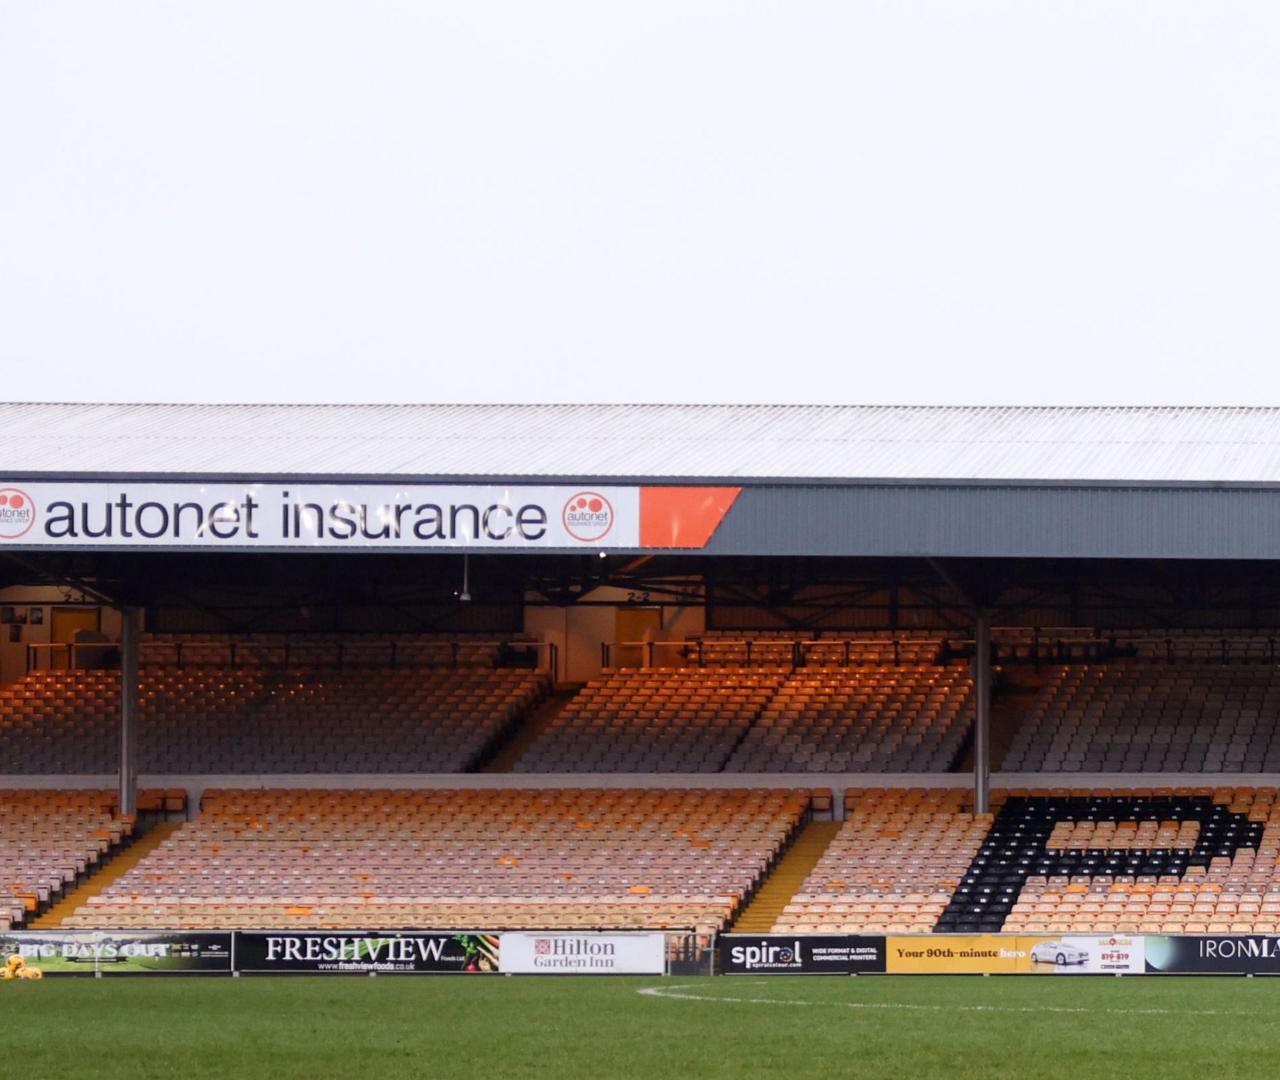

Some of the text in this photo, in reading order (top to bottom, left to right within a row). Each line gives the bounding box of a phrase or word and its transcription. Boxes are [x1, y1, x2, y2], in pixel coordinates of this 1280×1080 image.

[0, 508, 30, 518] tonet
[44, 490, 548, 541] autonet insurance
[568, 512, 608, 521] autonet
[627, 592, 650, 602] 2-2
[933, 797, 1265, 934] P
[19, 943, 55, 957] BIG
[62, 943, 119, 958] DAYS
[265, 937, 448, 961] FRESHVIEW
[553, 938, 615, 955] Hilton
[897, 947, 1026, 959] Your 90th-minute hero
[318, 962, 415, 970] www.freshviewfoods.co.uk
[533, 955, 614, 968] Garden Inn
